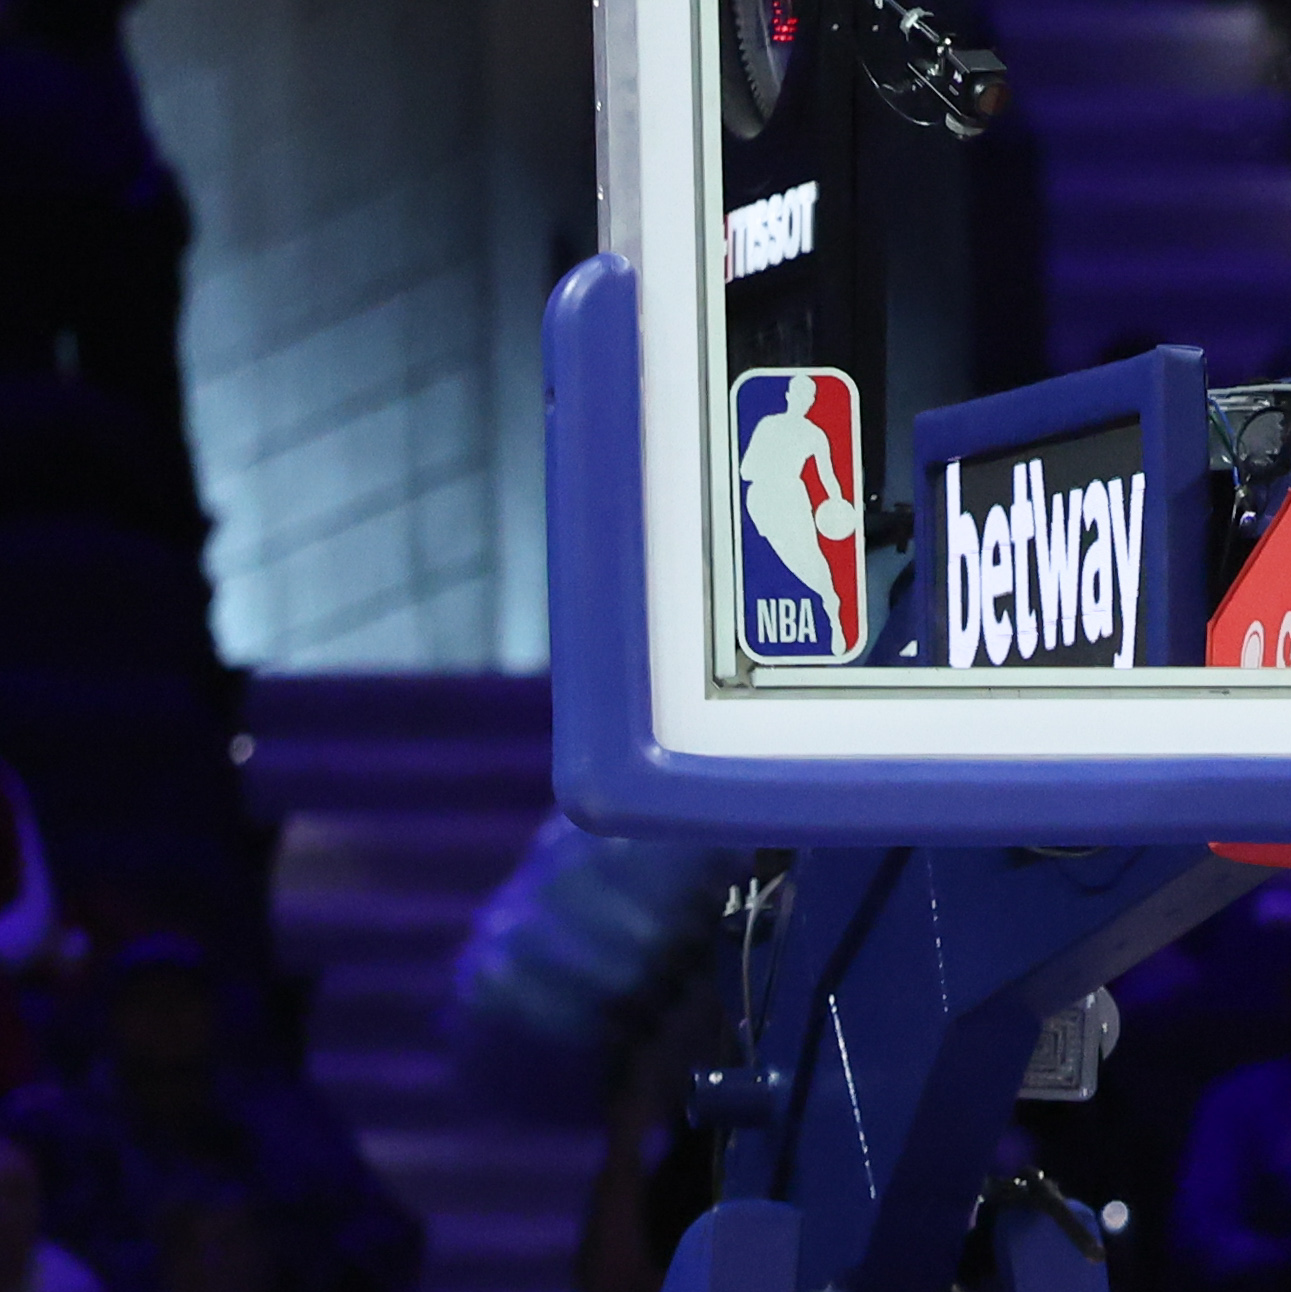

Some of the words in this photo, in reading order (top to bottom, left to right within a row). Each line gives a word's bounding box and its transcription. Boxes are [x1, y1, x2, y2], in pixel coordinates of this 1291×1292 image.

[729, 180, 818, 281] TISSOT
[946, 458, 1145, 669] betway
[756, 598, 818, 644] NBA
